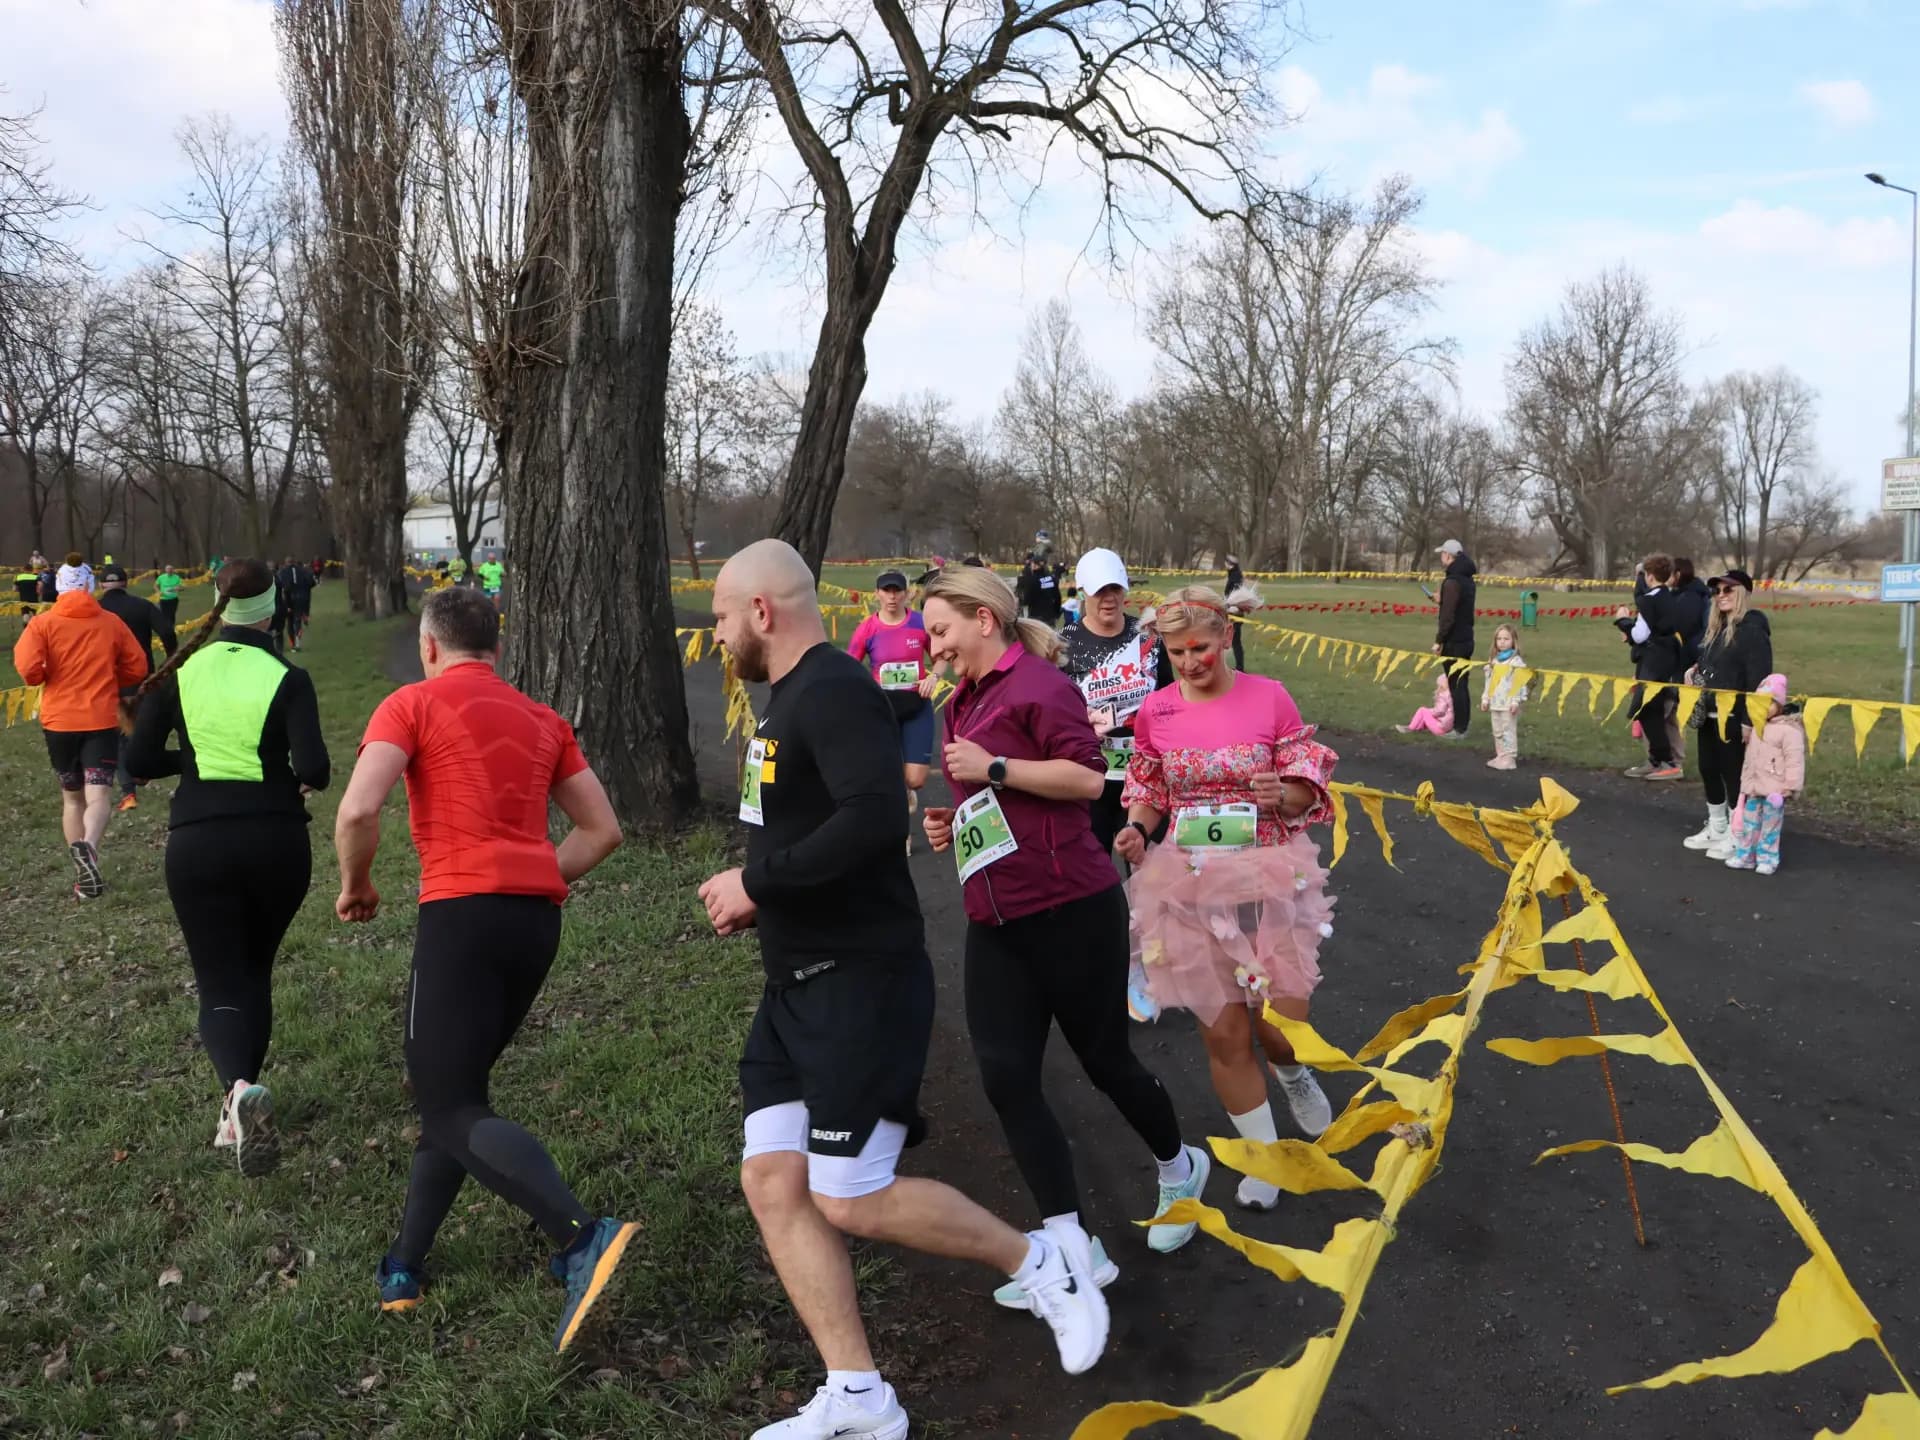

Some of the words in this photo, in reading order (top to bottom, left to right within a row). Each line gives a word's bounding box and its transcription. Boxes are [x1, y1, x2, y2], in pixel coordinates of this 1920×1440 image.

[892, 672, 907, 683] 12
[1089, 668, 1108, 681] XV
[1088, 676, 1122, 692] CROSS
[1207, 821, 1222, 843] 6
[961, 825, 984, 858] 50
